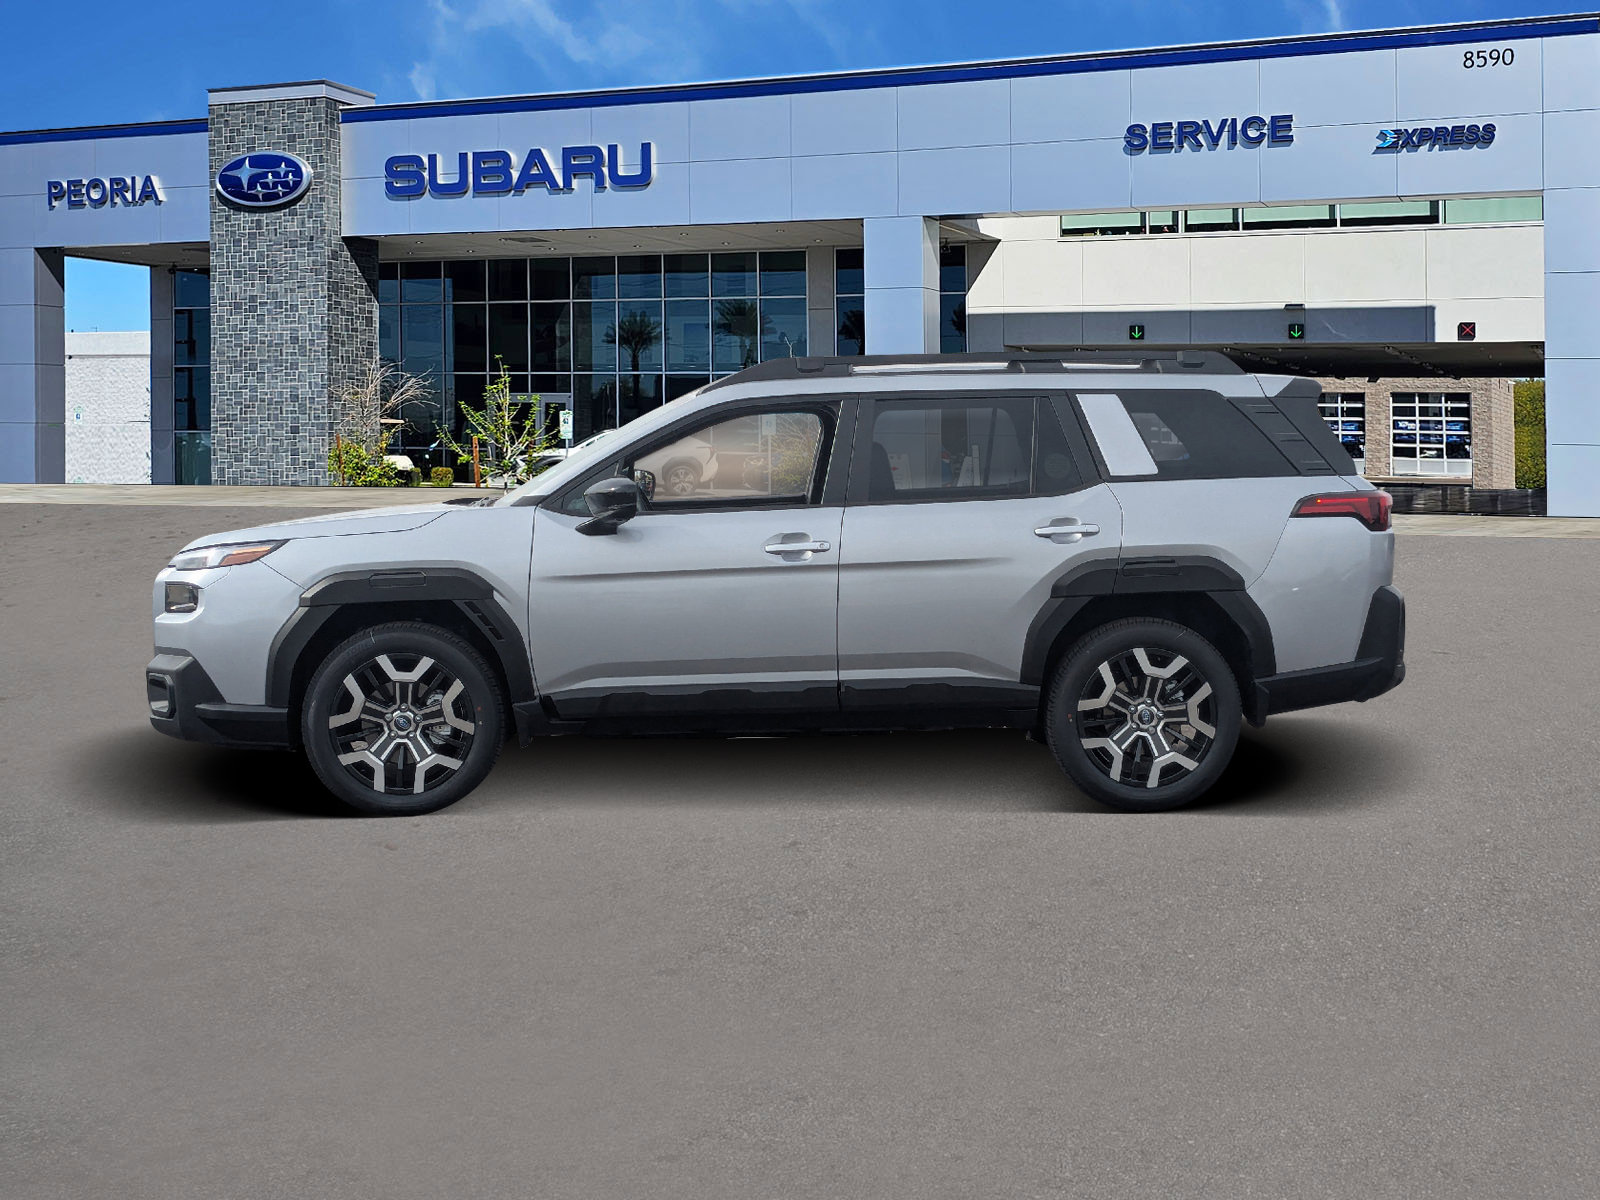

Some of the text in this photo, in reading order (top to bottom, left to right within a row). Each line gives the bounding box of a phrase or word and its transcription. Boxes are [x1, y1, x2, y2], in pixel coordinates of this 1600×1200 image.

[1463, 48, 1515, 69] 8590
[1125, 114, 1294, 151] SERVICE
[1376, 123, 1497, 149] EXPRESS
[384, 142, 654, 197] SUBARU
[47, 175, 164, 208] PEORIA
